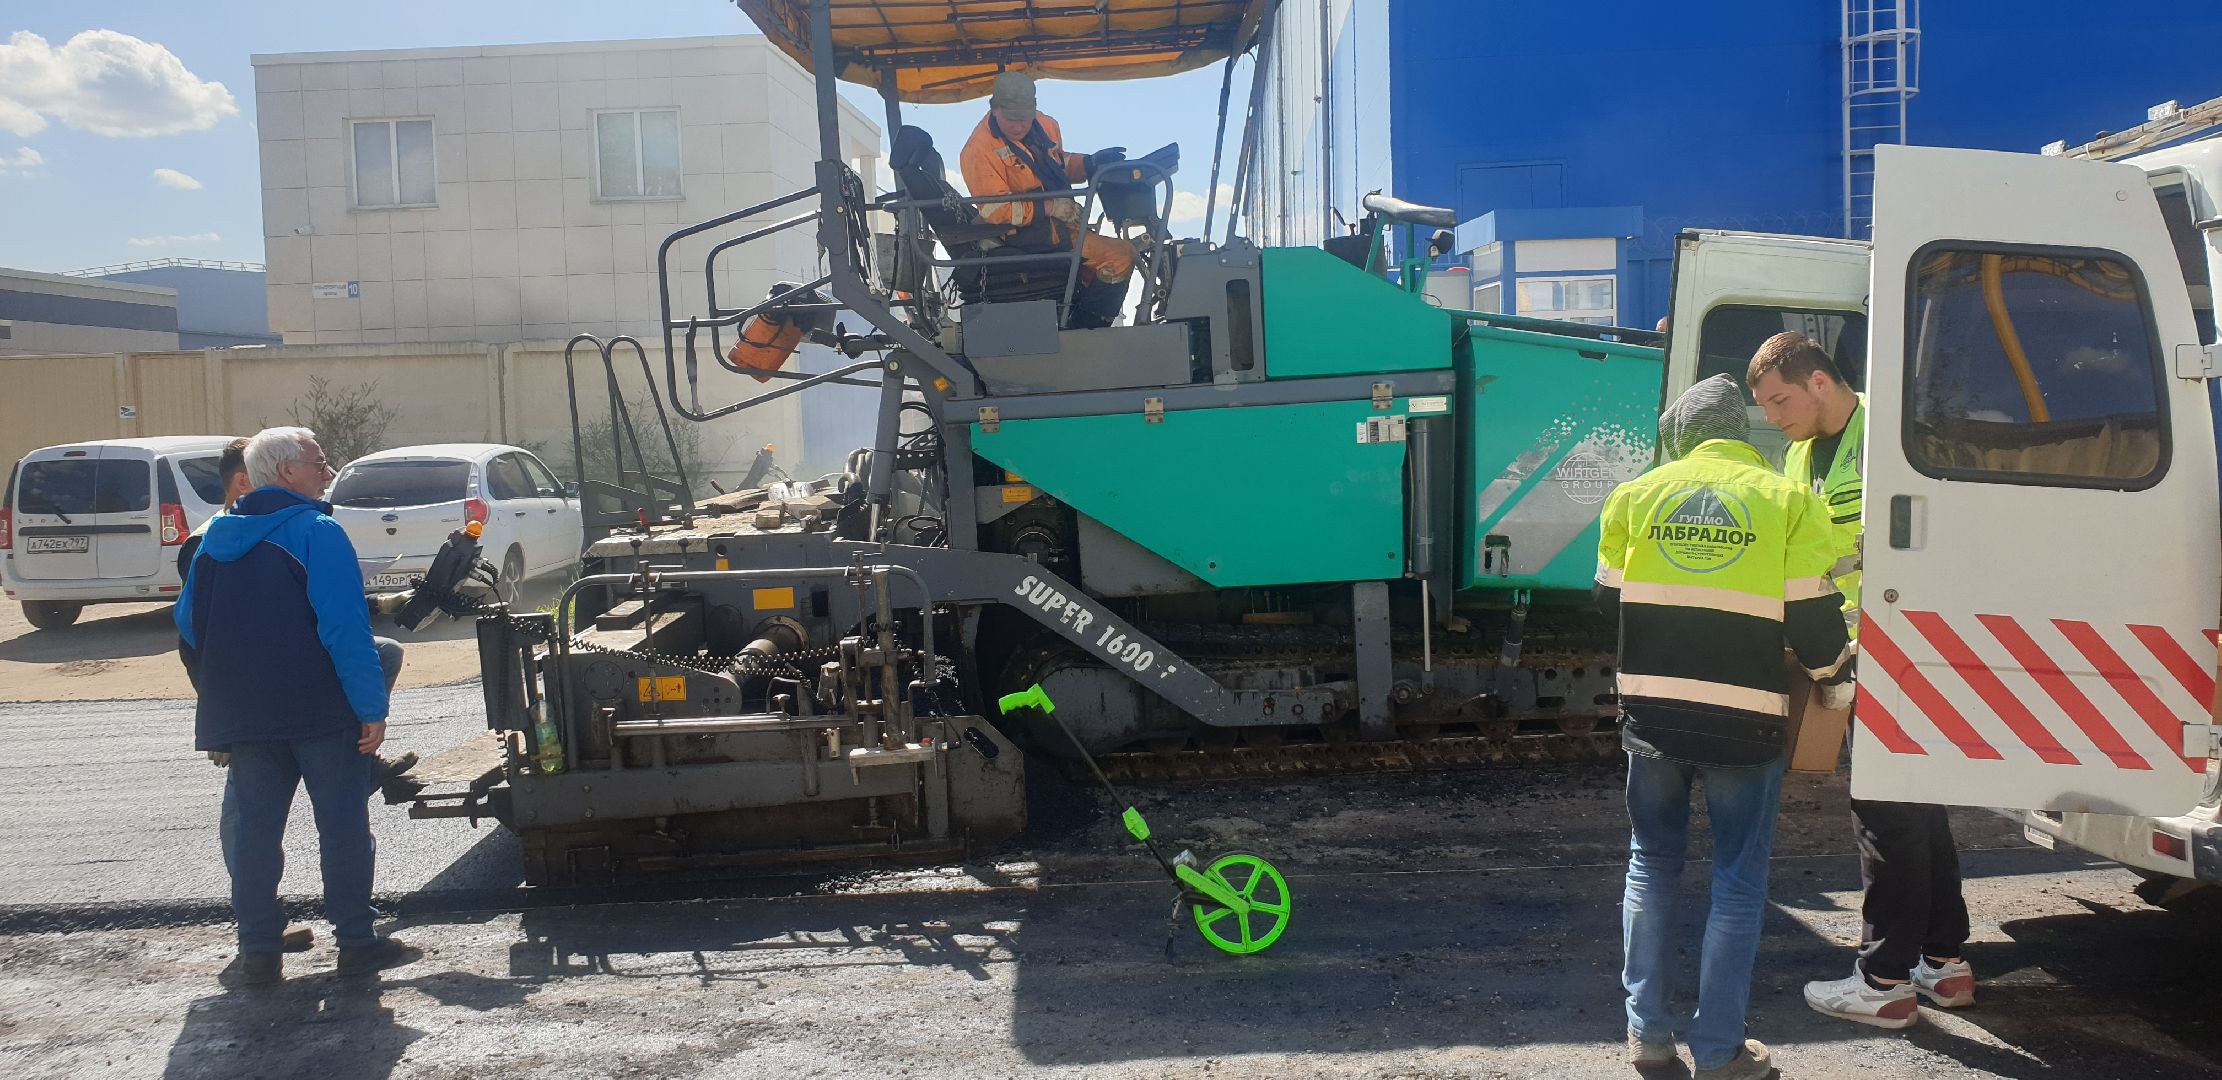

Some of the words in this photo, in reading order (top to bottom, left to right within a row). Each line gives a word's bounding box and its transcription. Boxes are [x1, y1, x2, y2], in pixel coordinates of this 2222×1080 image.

[349, 283, 358, 295] 10
[1561, 480, 1614, 489] GROUP
[1679, 514, 1702, 524] ГУП
[1703, 515, 1724, 526] МО
[1647, 525, 1757, 547] ЛАБРАДОР
[1014, 575, 1094, 635] SUPER
